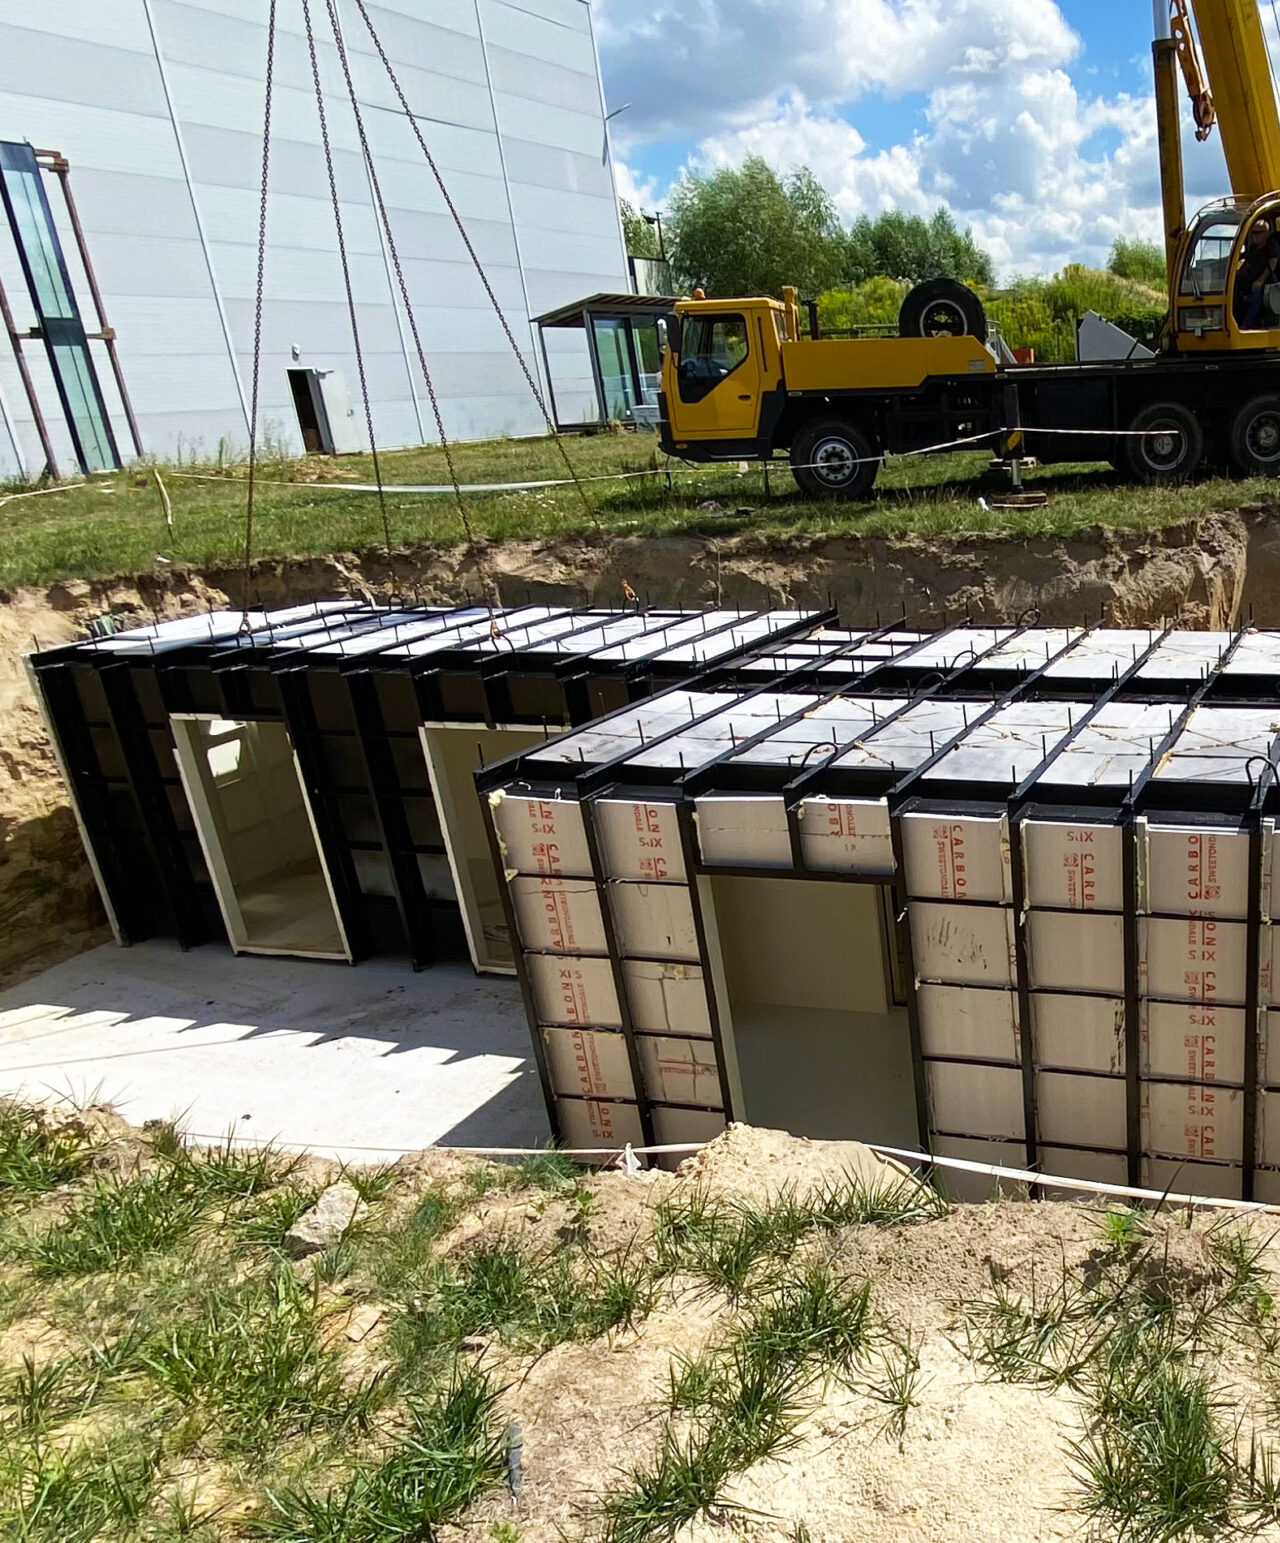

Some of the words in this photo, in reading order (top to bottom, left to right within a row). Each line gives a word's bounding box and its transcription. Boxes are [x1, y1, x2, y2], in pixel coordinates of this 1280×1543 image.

[649, 810, 660, 833] ON
[656, 858, 668, 878] CA
[1188, 836, 1198, 899] CARBO
[1206, 923, 1216, 946] ON
[572, 1031, 592, 1094] CARBON
